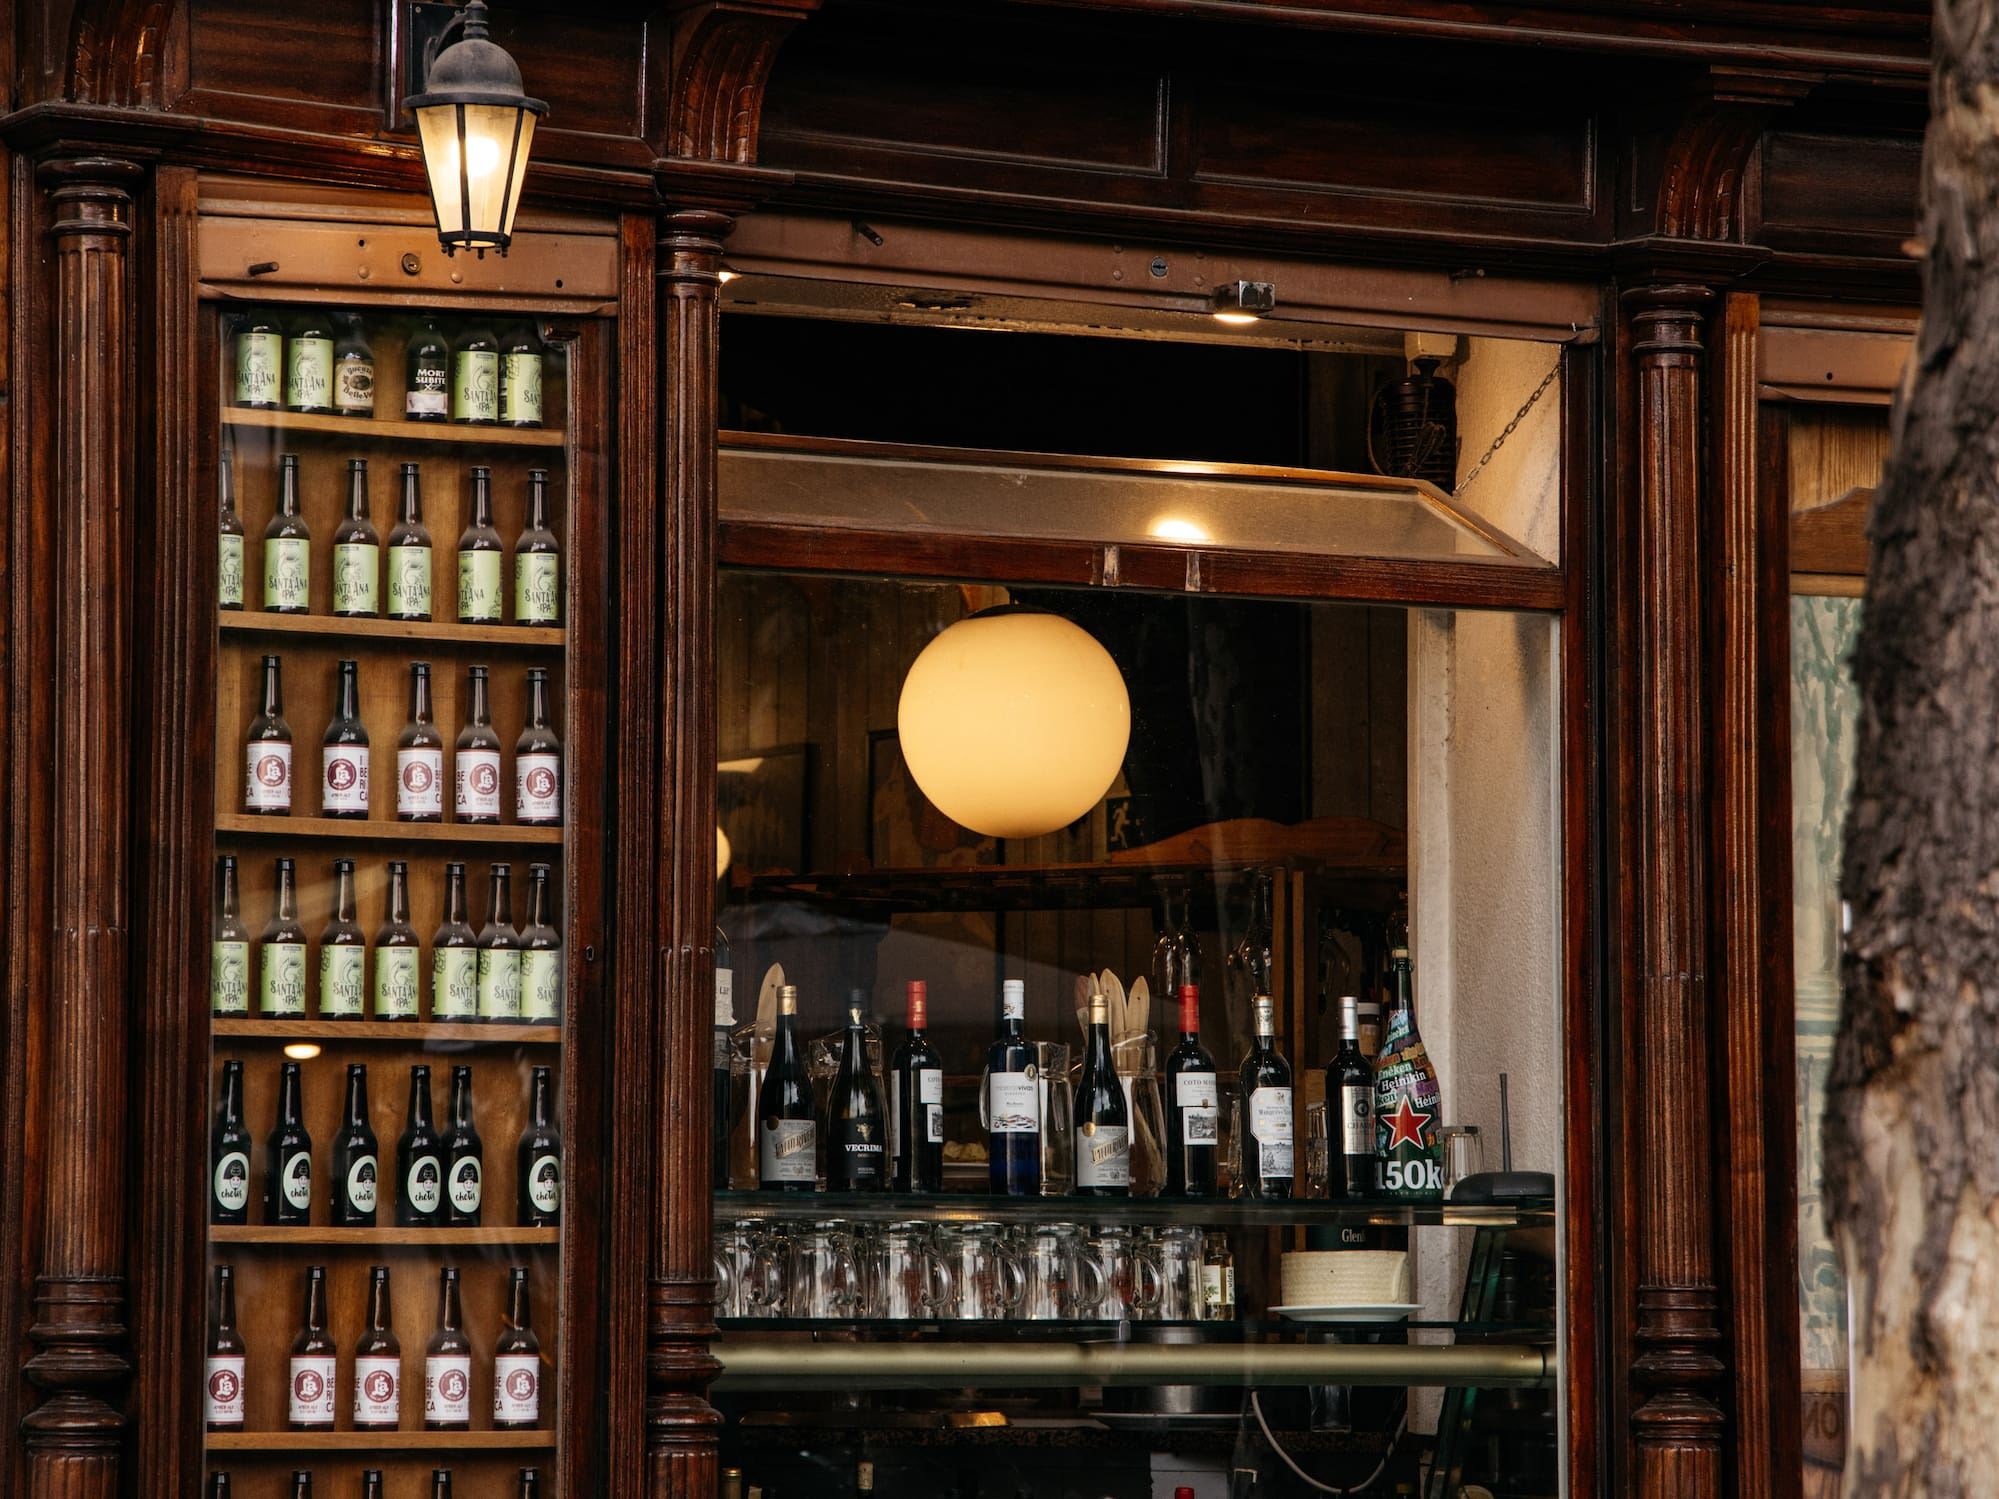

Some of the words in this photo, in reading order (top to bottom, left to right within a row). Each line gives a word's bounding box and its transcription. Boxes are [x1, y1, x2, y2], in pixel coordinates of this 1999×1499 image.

[417, 368, 446, 378] MORT
[1382, 1071, 1427, 1091] Heinikin
[1341, 1228, 1365, 1243] Glen
